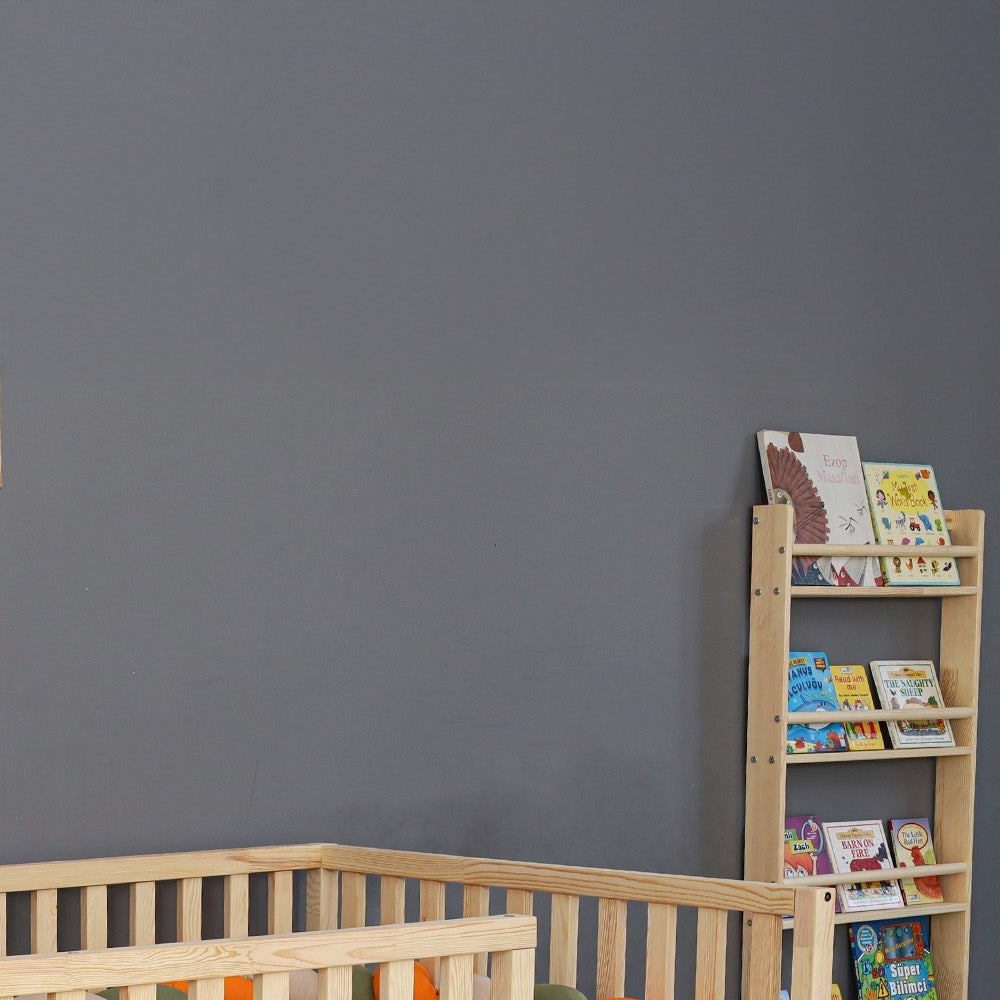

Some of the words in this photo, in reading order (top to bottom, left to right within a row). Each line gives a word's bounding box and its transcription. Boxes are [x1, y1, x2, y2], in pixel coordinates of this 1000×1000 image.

[822, 454, 848, 471] Ezop
[886, 493, 909, 507] Word
[910, 494, 929, 507] Book
[788, 666, 813, 681] ANUS
[834, 675, 851, 683] Read
[884, 679, 900, 688] THE
[901, 679, 934, 688] NAUGHTY
[900, 687, 923, 697] SHEEP
[792, 842, 810, 851] Zach
[841, 839, 863, 850] BARN
[863, 838, 875, 848] ON
[851, 849, 870, 858] FIRE
[890, 963, 921, 980] Süper
[889, 978, 928, 996] Bilimci
